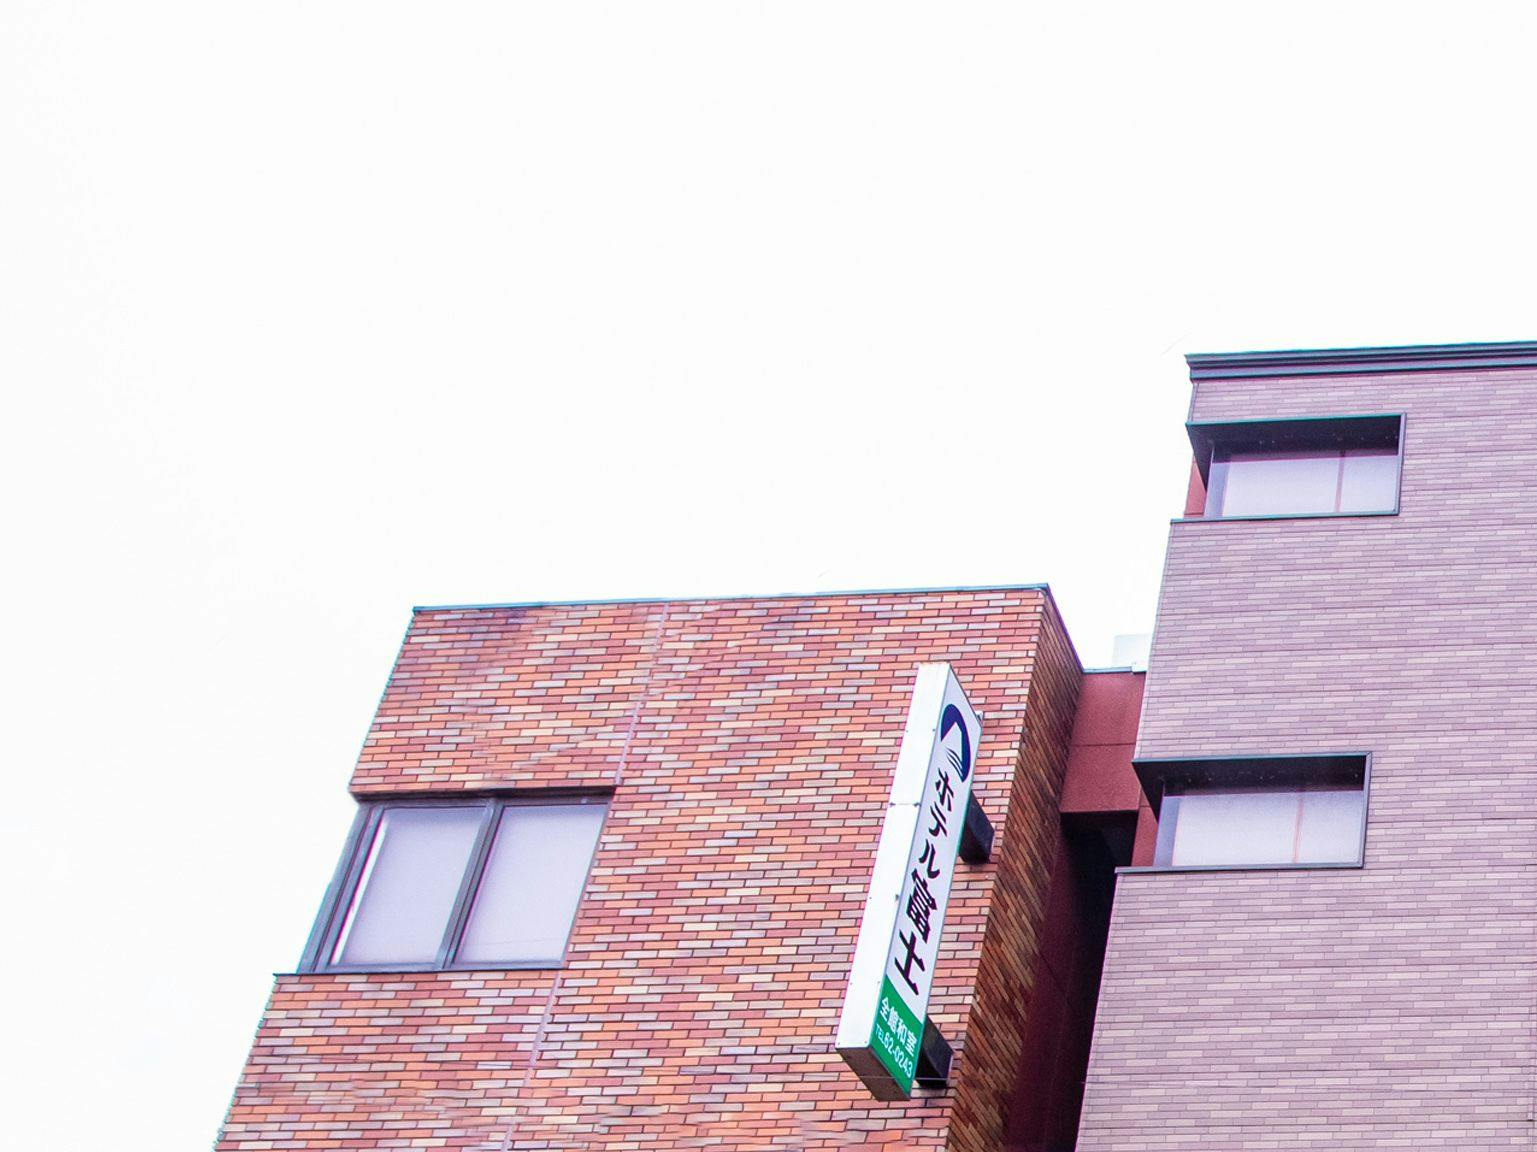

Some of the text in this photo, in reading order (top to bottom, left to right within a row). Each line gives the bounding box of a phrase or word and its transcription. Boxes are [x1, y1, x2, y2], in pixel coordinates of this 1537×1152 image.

[895, 767, 955, 996] ホテル富士
